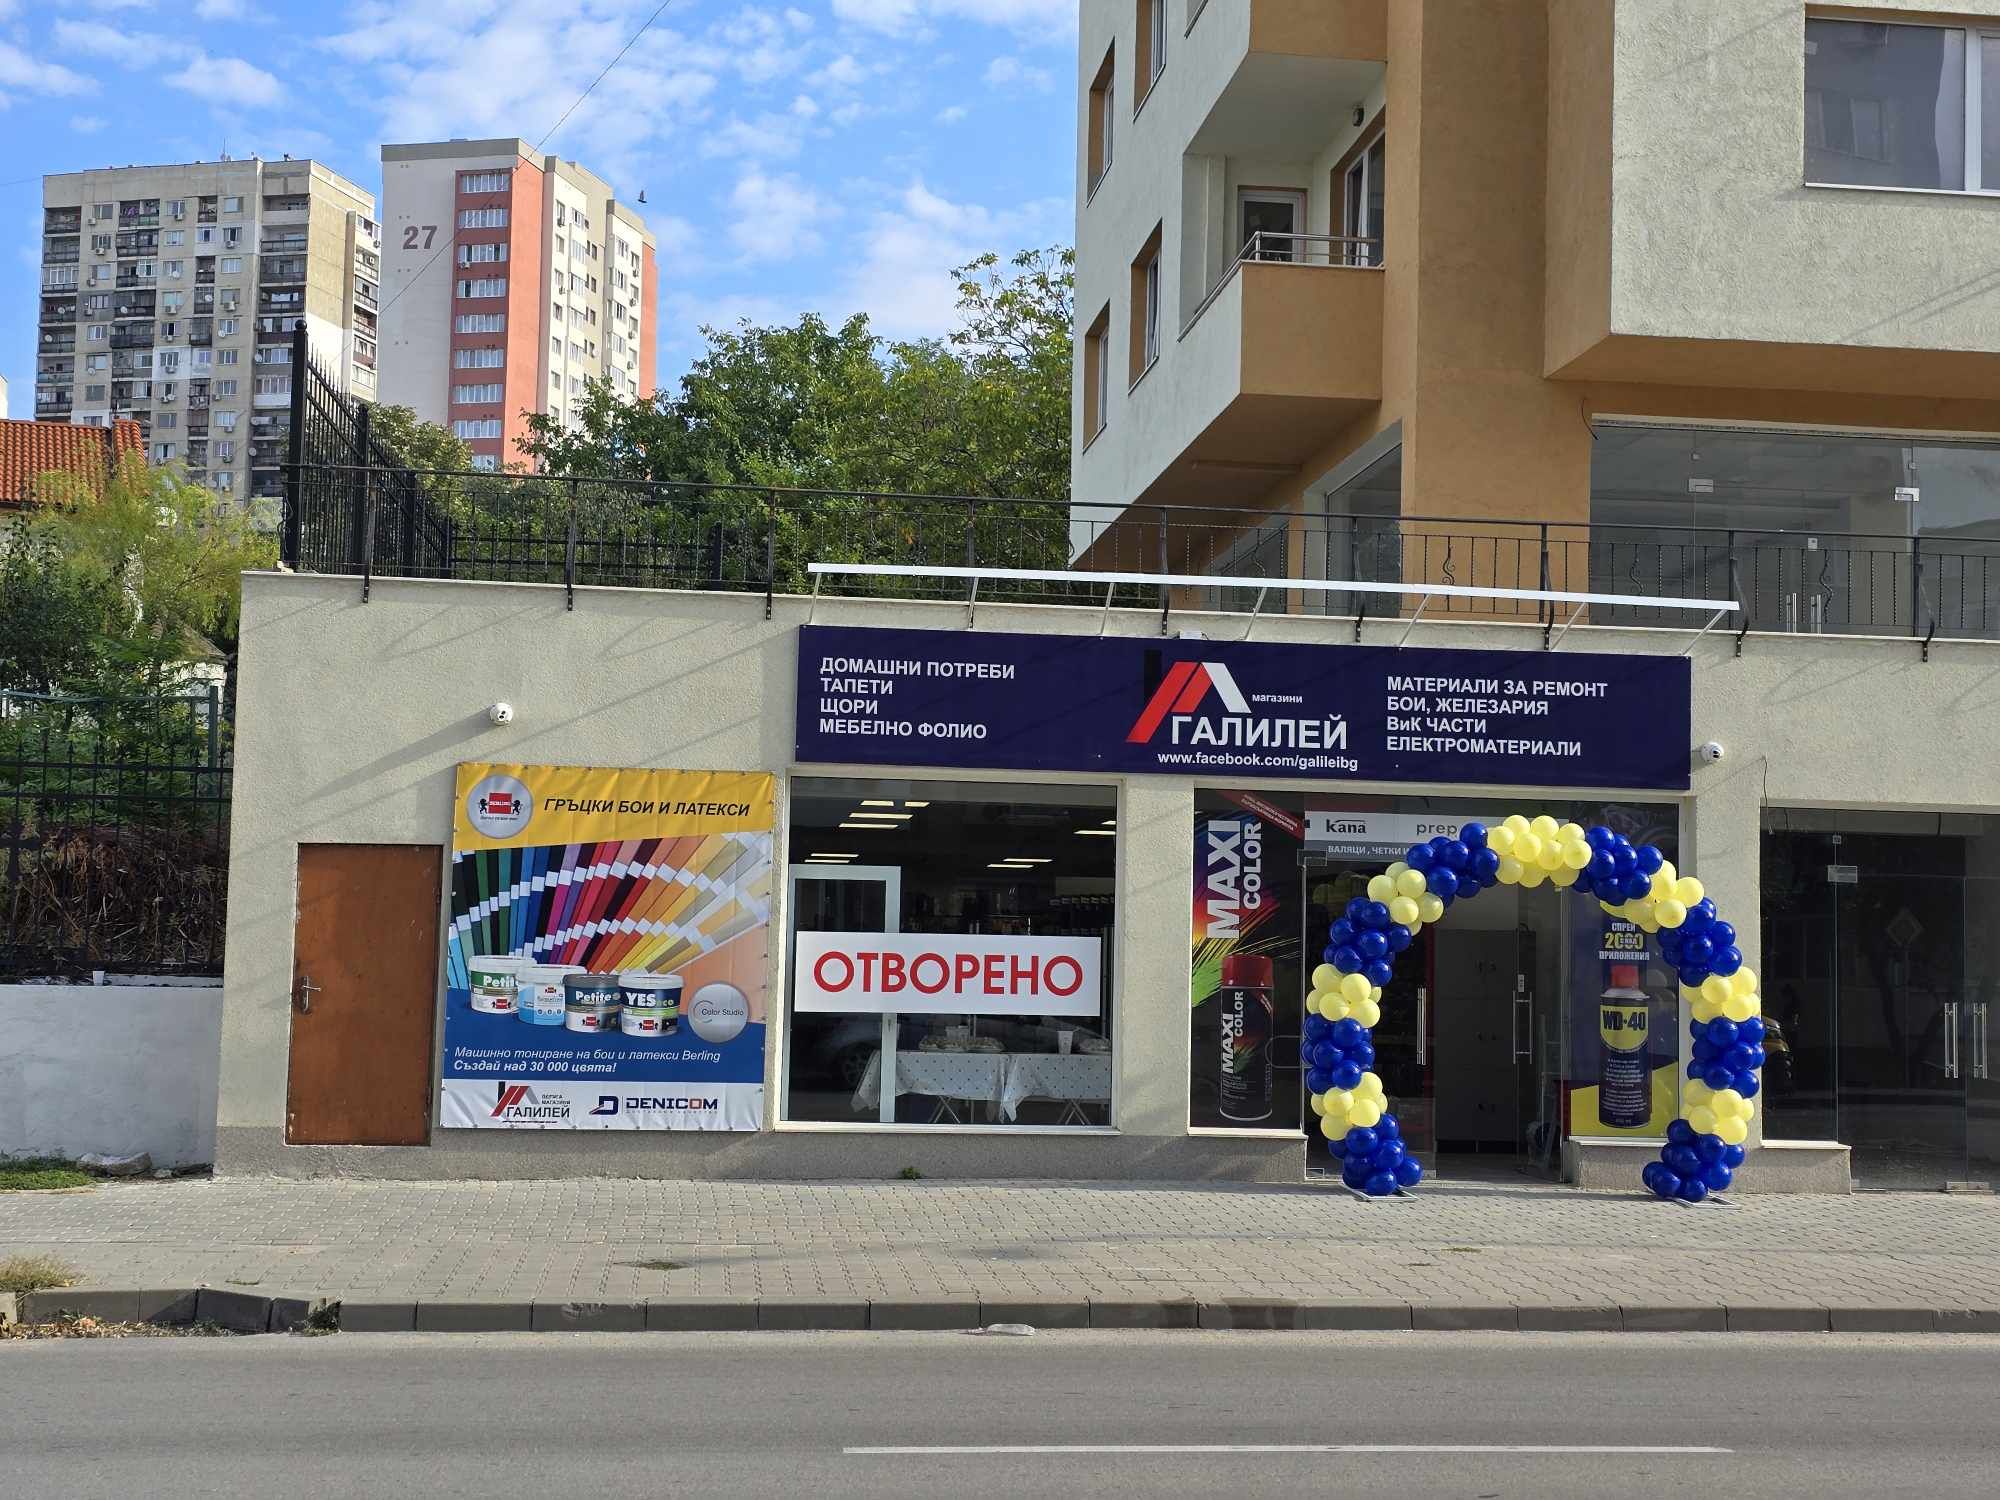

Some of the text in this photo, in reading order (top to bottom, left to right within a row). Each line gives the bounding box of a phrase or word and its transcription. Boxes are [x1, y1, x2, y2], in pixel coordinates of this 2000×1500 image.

[403, 225, 437, 249] 27
[820, 657, 1015, 679] ДОМАШНИ ПОТРЕБИ
[820, 677, 893, 695] ТАПЕТИ
[1387, 676, 1608, 697] МАТЕРИАЛИ ЗА РЕМОНТ
[820, 698, 878, 715] ЩОРИ
[1251, 694, 1303, 703] магазини
[1387, 696, 1549, 716] БОИ, ЖЕЛЕЗАРИЯ
[819, 718, 987, 739] МЕБЕЛНО ФОЛИО
[1171, 713, 1347, 750] ГАЛИЛЕЙ
[1386, 716, 1487, 734] ВиК ЧАСТИ
[1386, 736, 1582, 756] ЕЛЕКТРОМАТЕРИАЛИ
[1157, 752, 1358, 772] www.facebook.com/galileibg
[544, 798, 751, 817] ГРЪЦКИ БОИ И ЛАТЕКСИ
[1326, 819, 1366, 834] kana
[1372, 847, 1401, 855] ЧЕТКИ
[1243, 822, 1262, 910] COLOR
[1207, 820, 1240, 939] MAXI
[1599, 951, 1649, 961] ПРИЛОЖЕНИЯ
[483, 975, 519, 988] Petit
[814, 951, 1083, 996] ОТВОРЕНО
[575, 991, 612, 1002] Petite
[1234, 991, 1244, 1037] COLOR
[1222, 1013, 1235, 1074] MAXI
[454, 1046, 721, 1063] Машинно тониране на бои и латекси Berling
[453, 1059, 617, 1074] Създай над 30 000 цвята!
[506, 1104, 570, 1118] ГАЛИЛЕЙ
[626, 1097, 718, 1110] DENICOM
